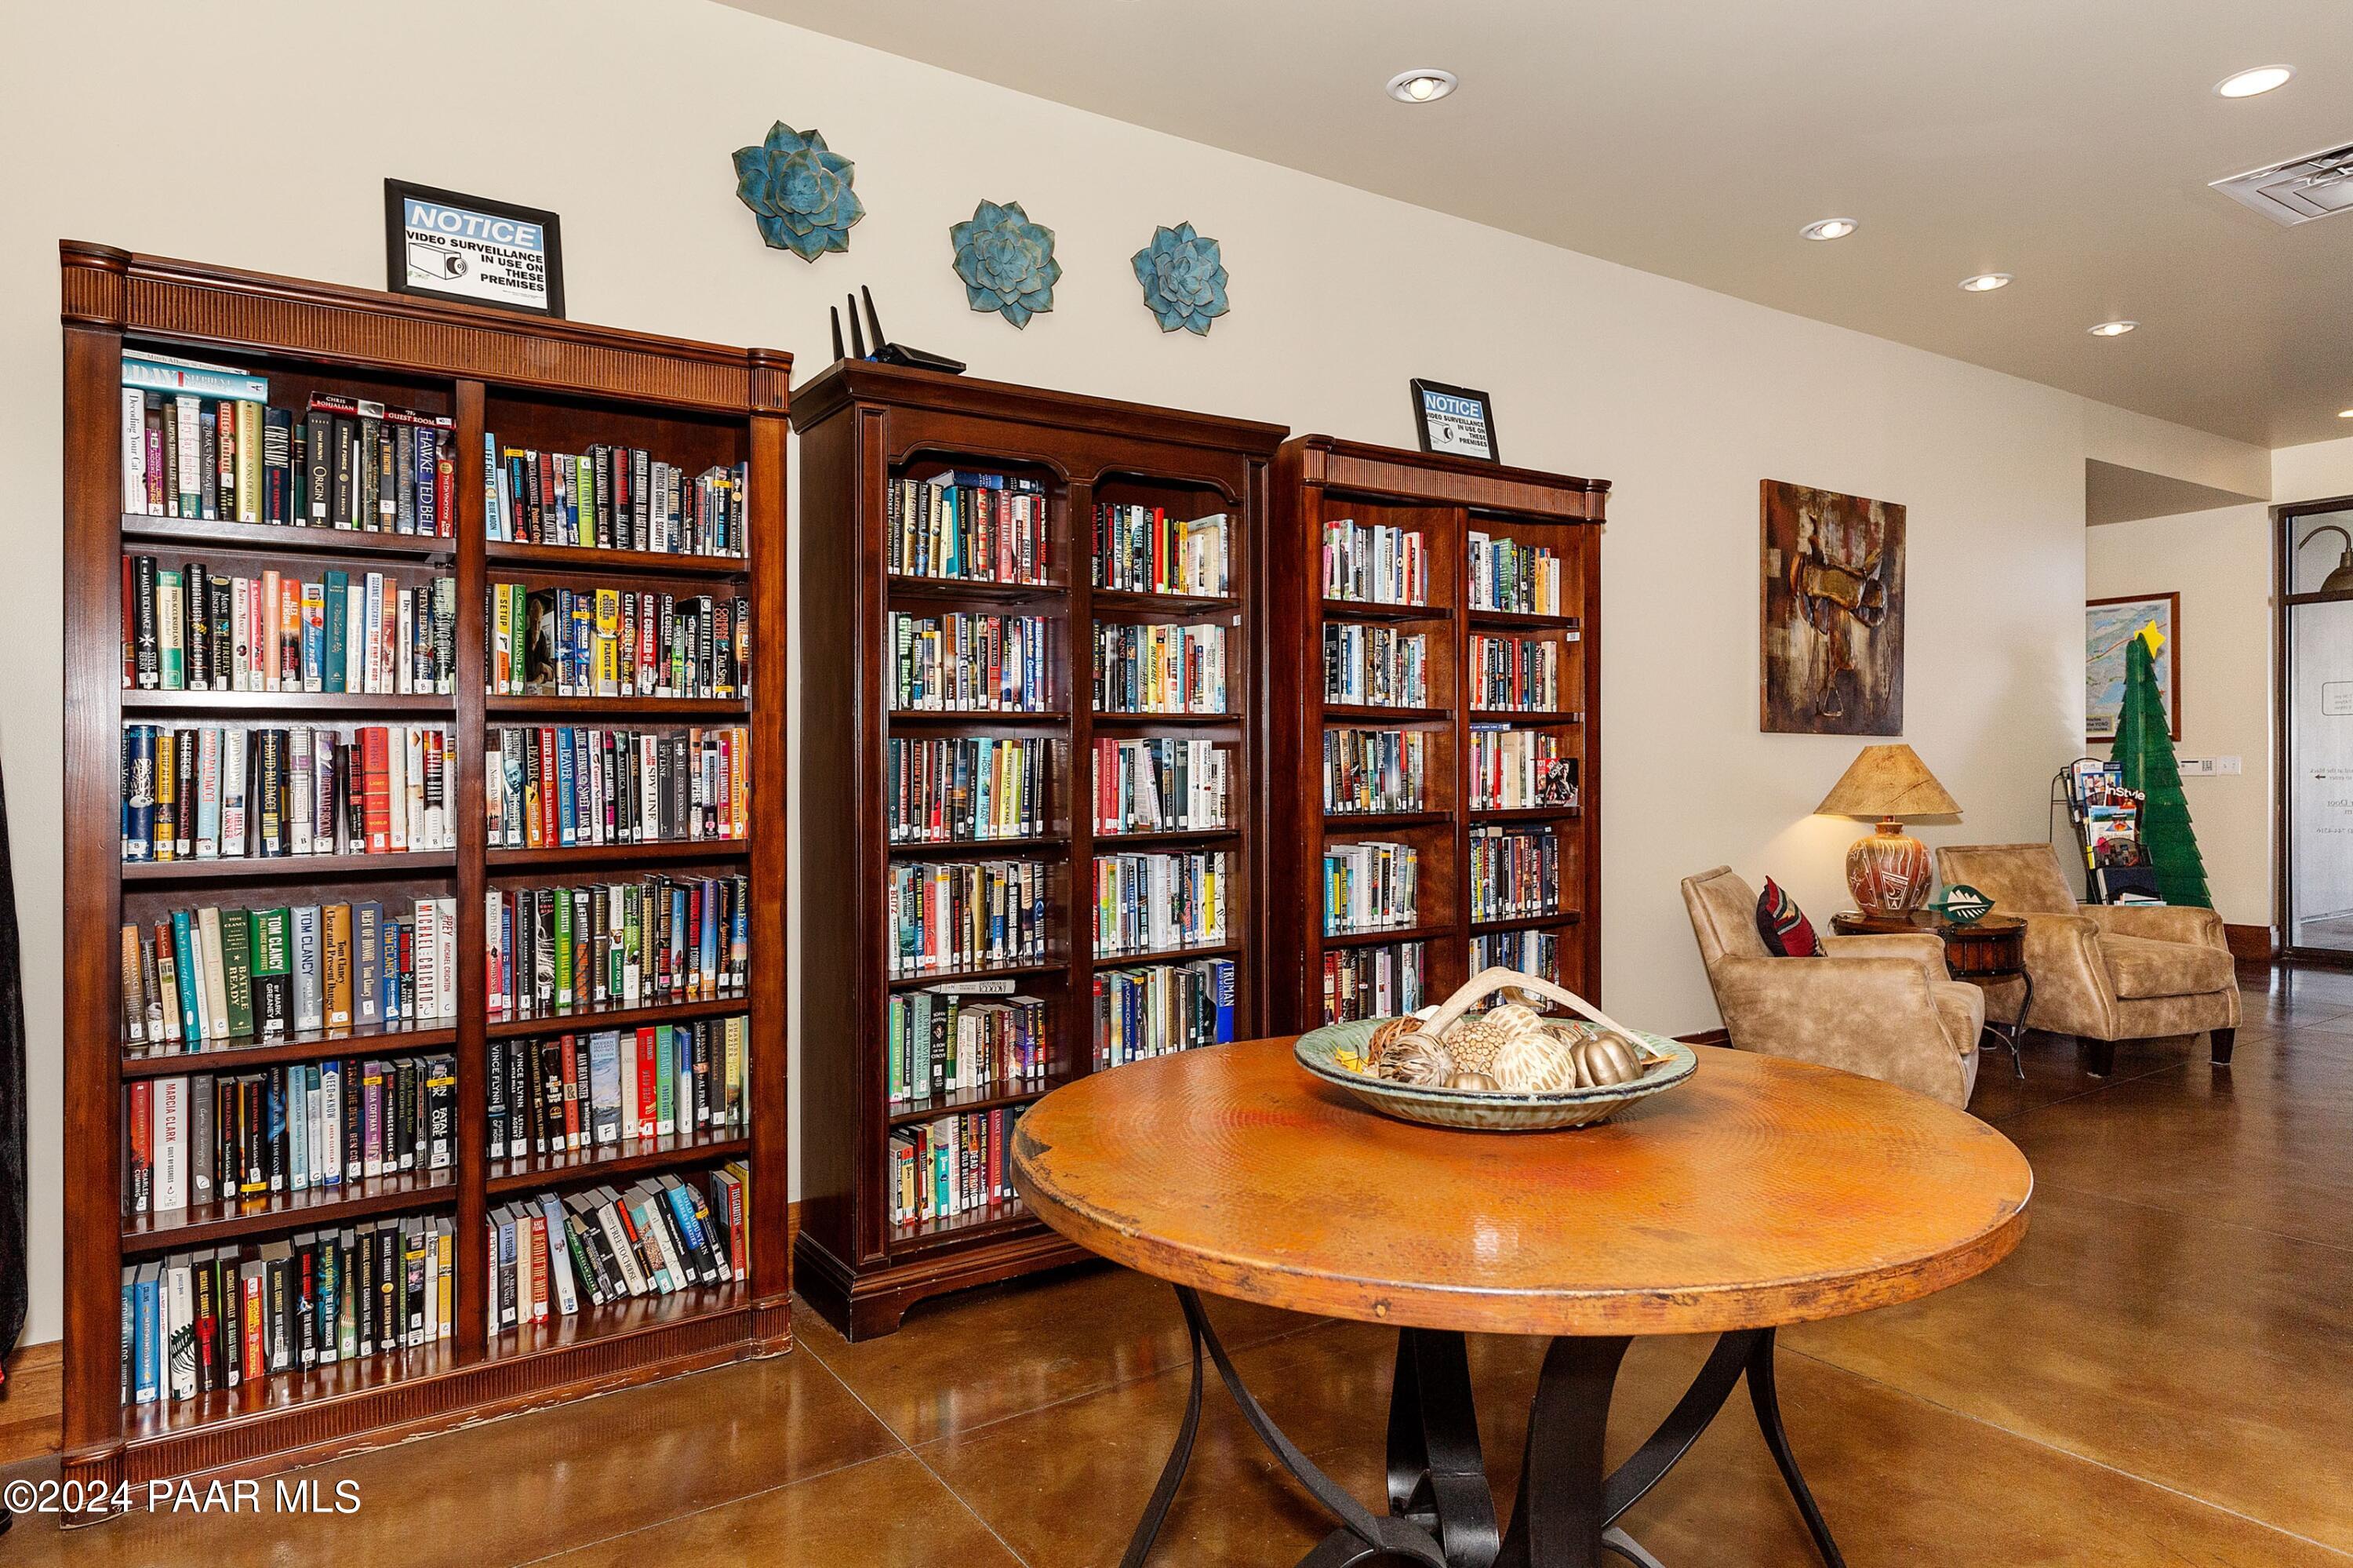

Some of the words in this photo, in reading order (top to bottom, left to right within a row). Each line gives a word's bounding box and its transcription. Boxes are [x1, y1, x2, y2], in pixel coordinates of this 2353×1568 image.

[411, 206, 536, 247] NOTICE
[406, 230, 446, 245] VIDEO
[450, 238, 543, 264] SURVEILLANCE
[481, 254, 494, 264] IN
[498, 257, 522, 269] USE
[526, 261, 543, 273] ON
[506, 268, 544, 282] THESE
[481, 274, 544, 292] PREMISES
[128, 395, 140, 433] Decoding
[389, 413, 413, 422] GUEST
[1425, 394, 1478, 417] NOTICE
[1444, 416, 1484, 428] SURVEILLANCE
[130, 436, 140, 456] Your
[420, 431, 433, 474] HAWKE
[1459, 438, 1487, 448] PREMISES
[131, 457, 141, 471] Cat
[596, 447, 607, 473] PATRICIA
[314, 467, 327, 500] ORIGIN
[486, 464, 494, 486] CHILD
[655, 467, 665, 489] PATRICIA
[420, 480, 433, 504] TED
[597, 474, 608, 504] CORNWELL
[655, 491, 664, 518] CORNWELL
[191, 574, 202, 620] IMMORTALISTS
[282, 592, 291, 624] BERENSON
[624, 594, 634, 619] CLIVE
[643, 595, 653, 617] CLIVE
[419, 615, 427, 642] BERRY
[624, 620, 634, 655] CUSSLER
[643, 619, 653, 653] CUSSLER
[899, 617, 911, 655] Griffin
[901, 660, 911, 683] Black
[204, 731, 216, 757] DAVID
[576, 729, 586, 746] JUDE
[528, 746, 539, 779] DEAVER
[544, 758, 552, 781] DEAVER
[561, 749, 572, 779] DEAVER
[202, 759, 215, 802] BALDACCI
[264, 770, 276, 809] BALDACCI
[427, 781, 442, 801] BARR
[691, 777, 701, 803] VIPERS
[577, 787, 590, 809] SWEET
[648, 792, 656, 820] LINE
[224, 810, 233, 839] CORNER
[580, 811, 589, 827] LIAR
[737, 880, 747, 912] FANNIE
[890, 890, 899, 915] BLITZ
[267, 916, 282, 935] TOM
[300, 911, 312, 933] TOM
[326, 911, 335, 931] Clear
[362, 910, 374, 926] DEBT
[418, 905, 433, 951] MICHAEL
[442, 915, 453, 937] PREY
[577, 904, 589, 942] JUDGMENT
[737, 913, 747, 939] FLAGG
[362, 929, 374, 937] OF
[268, 937, 282, 970] CLANCY
[301, 936, 314, 976] CLANCY
[337, 940, 346, 956] Tom
[362, 939, 375, 962] HONOR
[326, 950, 336, 981] Present
[335, 959, 346, 984] Clancy
[364, 966, 373, 978] Tom
[383, 946, 394, 979] CLANCY
[229, 966, 238, 1006] READY
[239, 966, 249, 1011] BATTLE
[326, 982, 336, 1012] Danger
[361, 979, 374, 997] Clancy
[1224, 966, 1235, 1006] TRUMAN
[326, 1075, 335, 1093] NEED
[166, 1083, 176, 1114] MARCIA
[327, 1100, 336, 1119] KNOW
[347, 1090, 358, 1106] THE
[166, 1117, 176, 1143] CLARK
[348, 1107, 358, 1130] DEVIL
[349, 1133, 358, 1148] BEN
[969, 1151, 979, 1169] DEAD
[732, 1188, 740, 1199] TESS
[533, 1233, 545, 1255] DEATH
[609, 1225, 624, 1246] FREE
[325, 1246, 333, 1267] MICHAEL
[616, 1246, 626, 1257] TO
[227, 1270, 235, 1291] MICHAEL
[533, 1266, 546, 1278] THE
[620, 1255, 638, 1282] CHOOSE
[199, 1271, 209, 1293] MICHAEL
[534, 1279, 546, 1303] WHEEL
[200, 1294, 209, 1319] CONNELLY
[227, 1293, 235, 1318] CONNELLY
